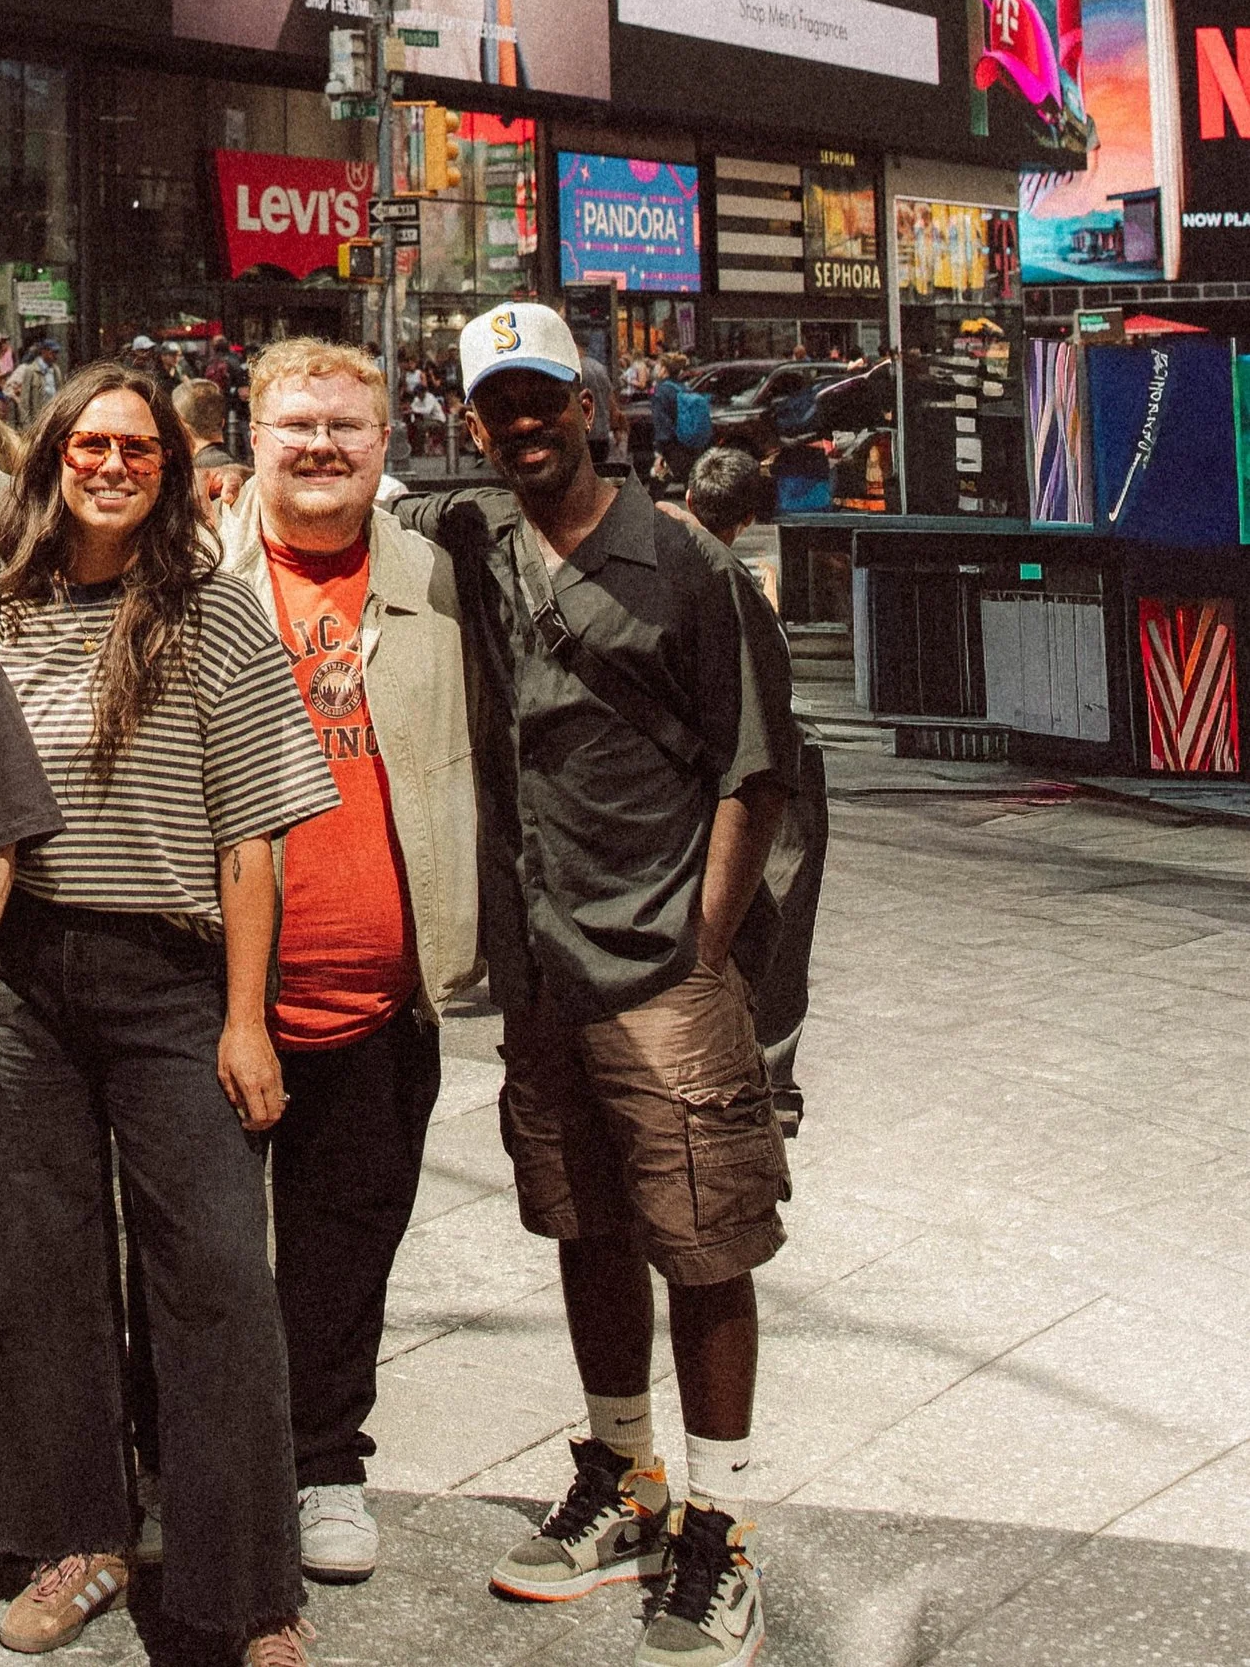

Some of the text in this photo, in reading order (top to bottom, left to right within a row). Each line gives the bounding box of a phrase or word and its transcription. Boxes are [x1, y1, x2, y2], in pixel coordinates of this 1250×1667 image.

[820, 149, 855, 167] SEPHORA
[583, 200, 679, 242] PANDORA
[1182, 212, 1222, 228] NOW
[814, 262, 882, 289] SEPHORA
[491, 310, 521, 355] S
